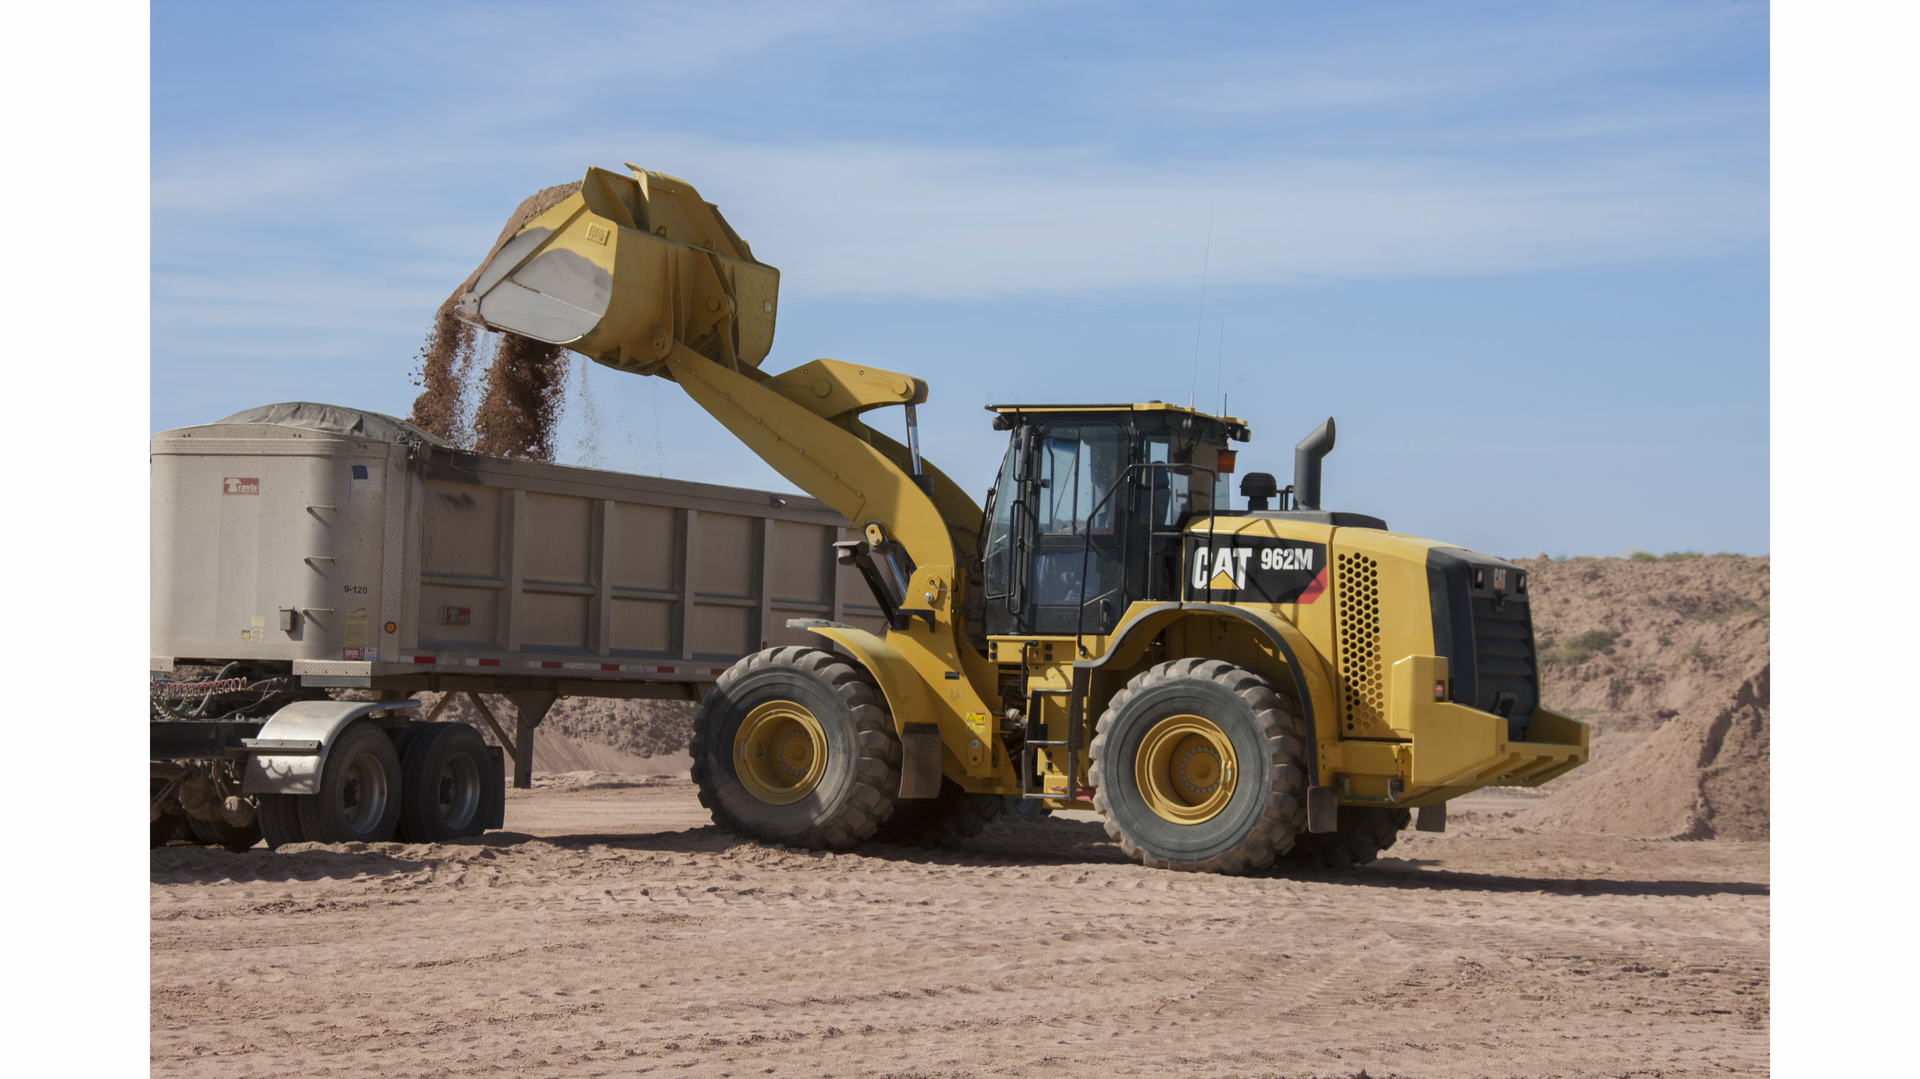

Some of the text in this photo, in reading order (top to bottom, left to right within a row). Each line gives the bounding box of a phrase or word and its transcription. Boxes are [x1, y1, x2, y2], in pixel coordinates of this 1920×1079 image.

[225, 478, 258, 492] Travis
[1192, 547, 1313, 590] CAT 962M
[1494, 568, 1506, 589] CAT
[344, 585, 368, 594] 9-120
